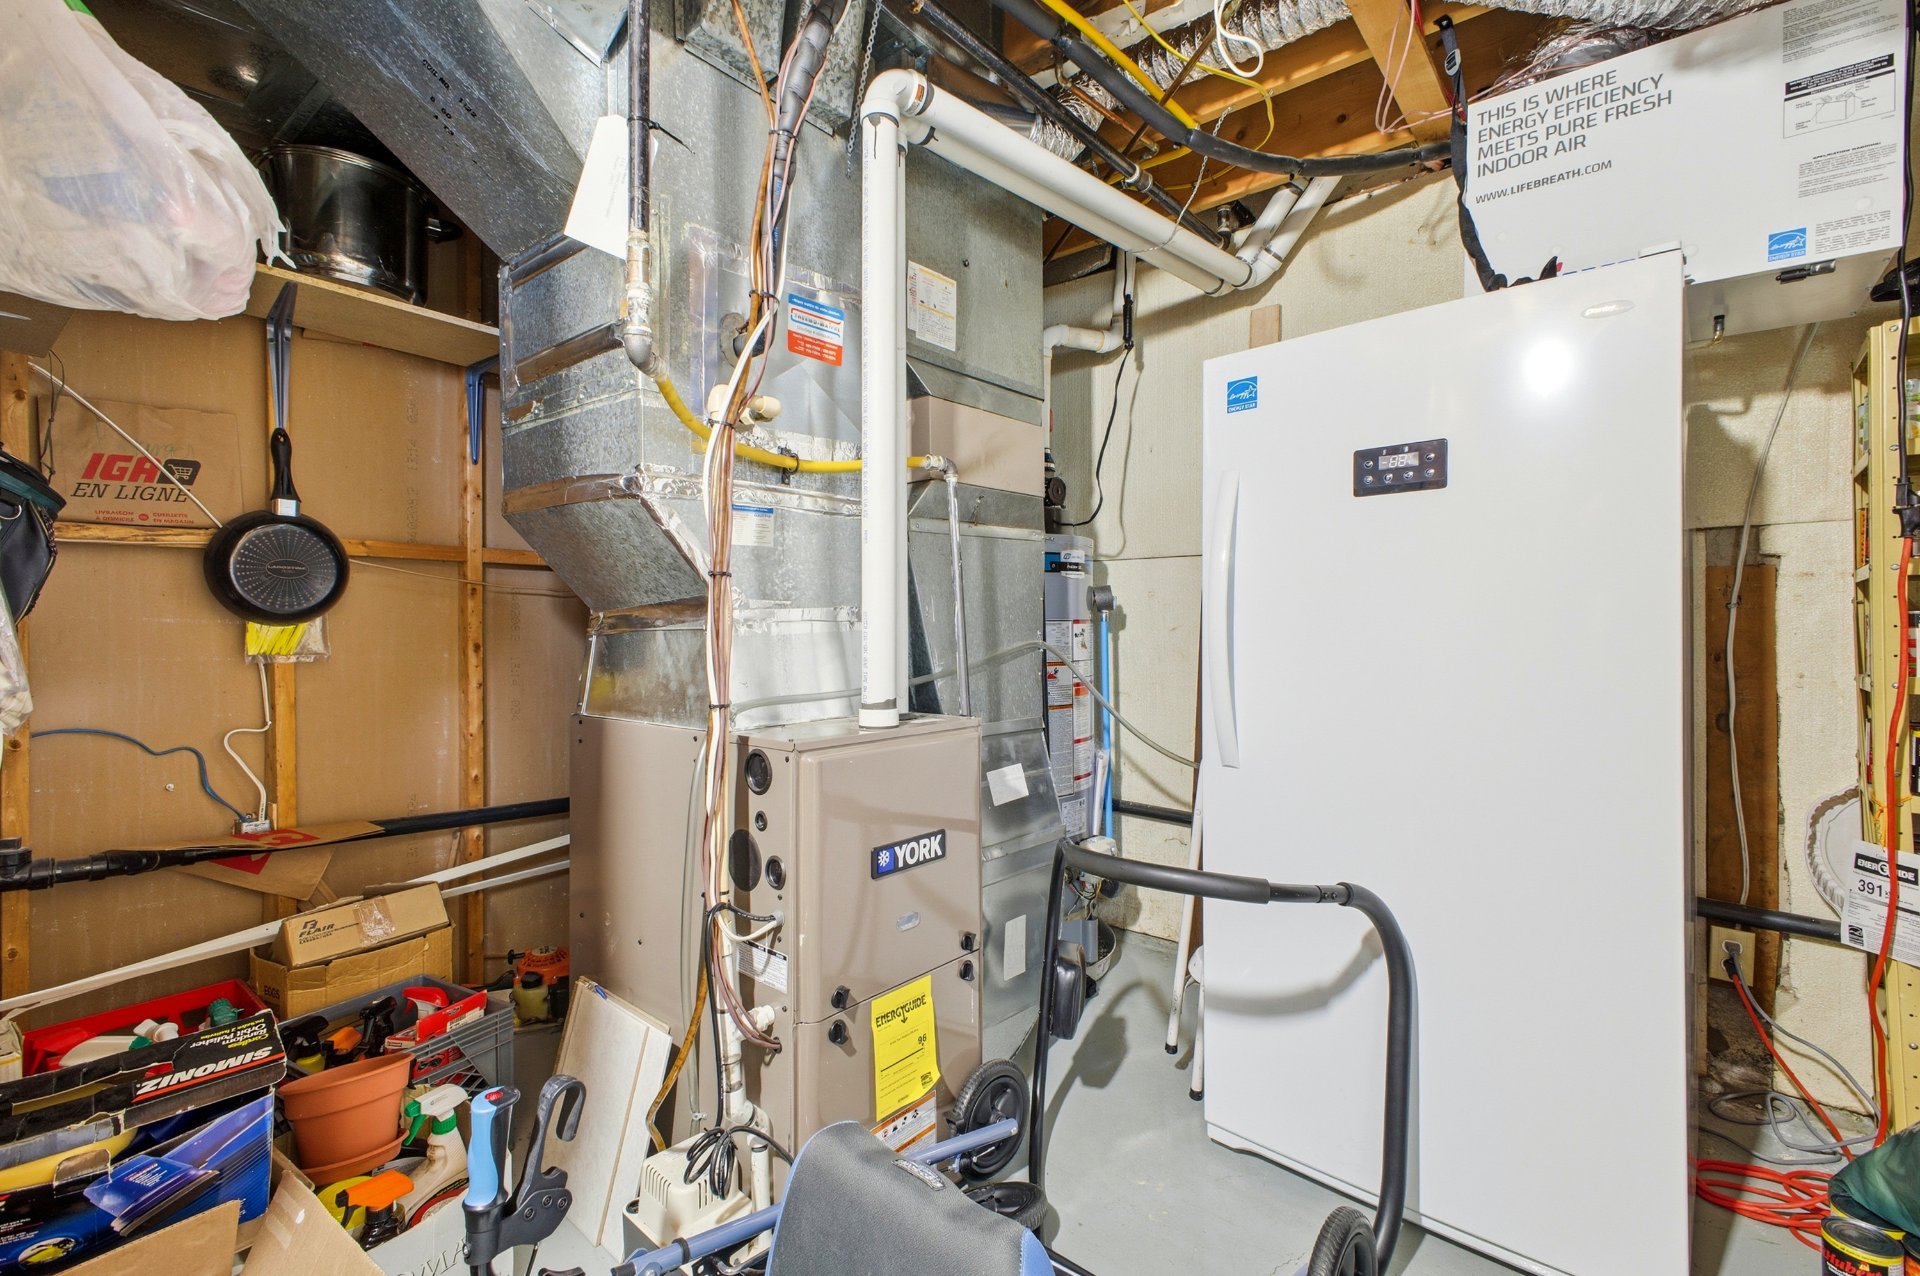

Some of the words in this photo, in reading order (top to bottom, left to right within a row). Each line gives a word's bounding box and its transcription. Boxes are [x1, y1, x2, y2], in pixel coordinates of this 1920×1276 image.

[1478, 102, 1516, 126] THIS
[1524, 94, 1539, 112] IS
[1546, 70, 1617, 104] WHERE
[1478, 109, 1548, 144] ENERGY
[1554, 73, 1664, 120] EFFICIENCY
[1478, 130, 1538, 160] MEETS
[1546, 112, 1598, 141] PURE
[1604, 90, 1672, 123] FRESH
[1478, 146, 1548, 178] INDOOR
[1554, 134, 1586, 156] AIR
[1476, 160, 1612, 204] WWW.LIFEBREATH.COM
[81, 453, 162, 484] IGA
[70, 482, 110, 498] EN
[114, 484, 190, 502] LIGNE
[894, 834, 942, 868] YORK
[1857, 858, 1916, 881] ENERGIDE
[1858, 879, 1882, 898] 391
[299, 924, 335, 938] FLAIR
[876, 994, 926, 1028] ENERGYGUIDE
[190, 1032, 236, 1049] Polisher
[222, 1028, 267, 1046] Random
[236, 1024, 266, 1038] Orbit
[136, 1046, 273, 1096] SIMONIZ
